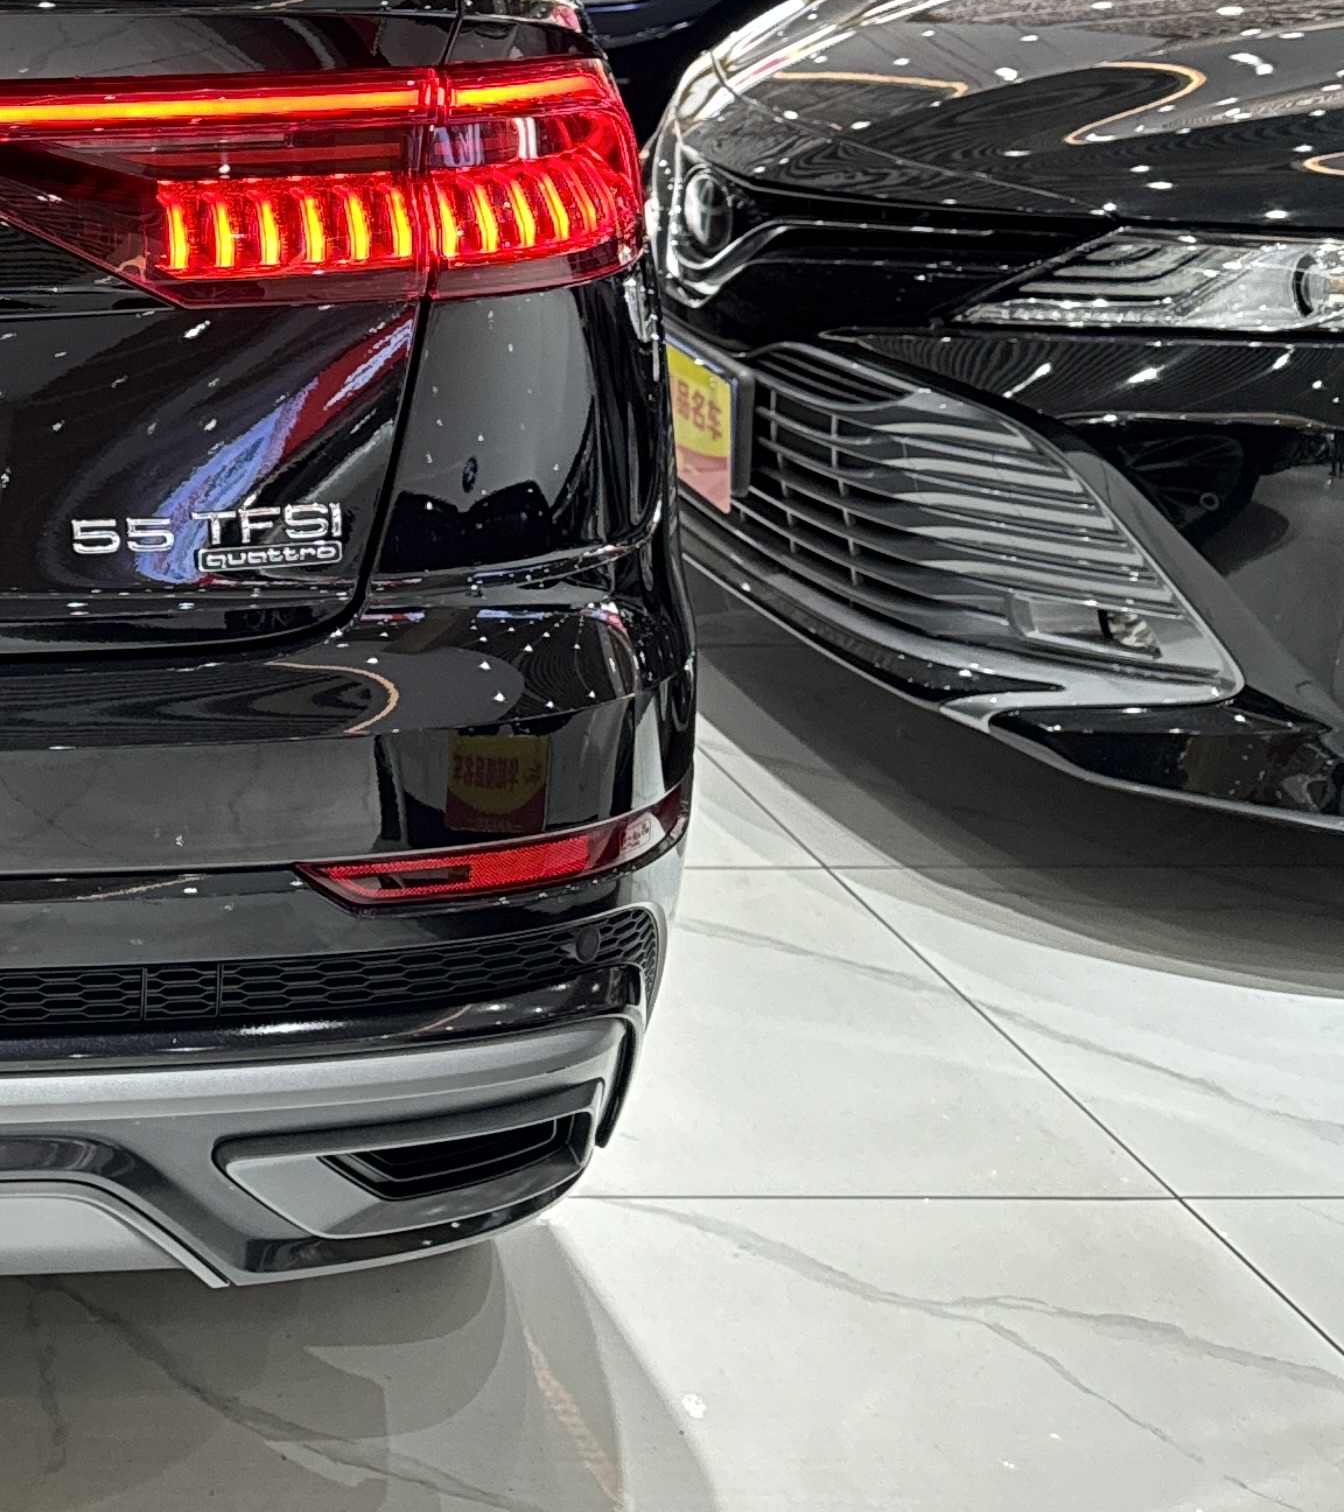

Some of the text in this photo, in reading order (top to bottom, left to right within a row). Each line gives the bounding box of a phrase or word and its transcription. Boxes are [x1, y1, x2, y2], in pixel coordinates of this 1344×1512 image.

[71, 502, 342, 554] 55 TFSI
[205, 545, 338, 569] quattro
